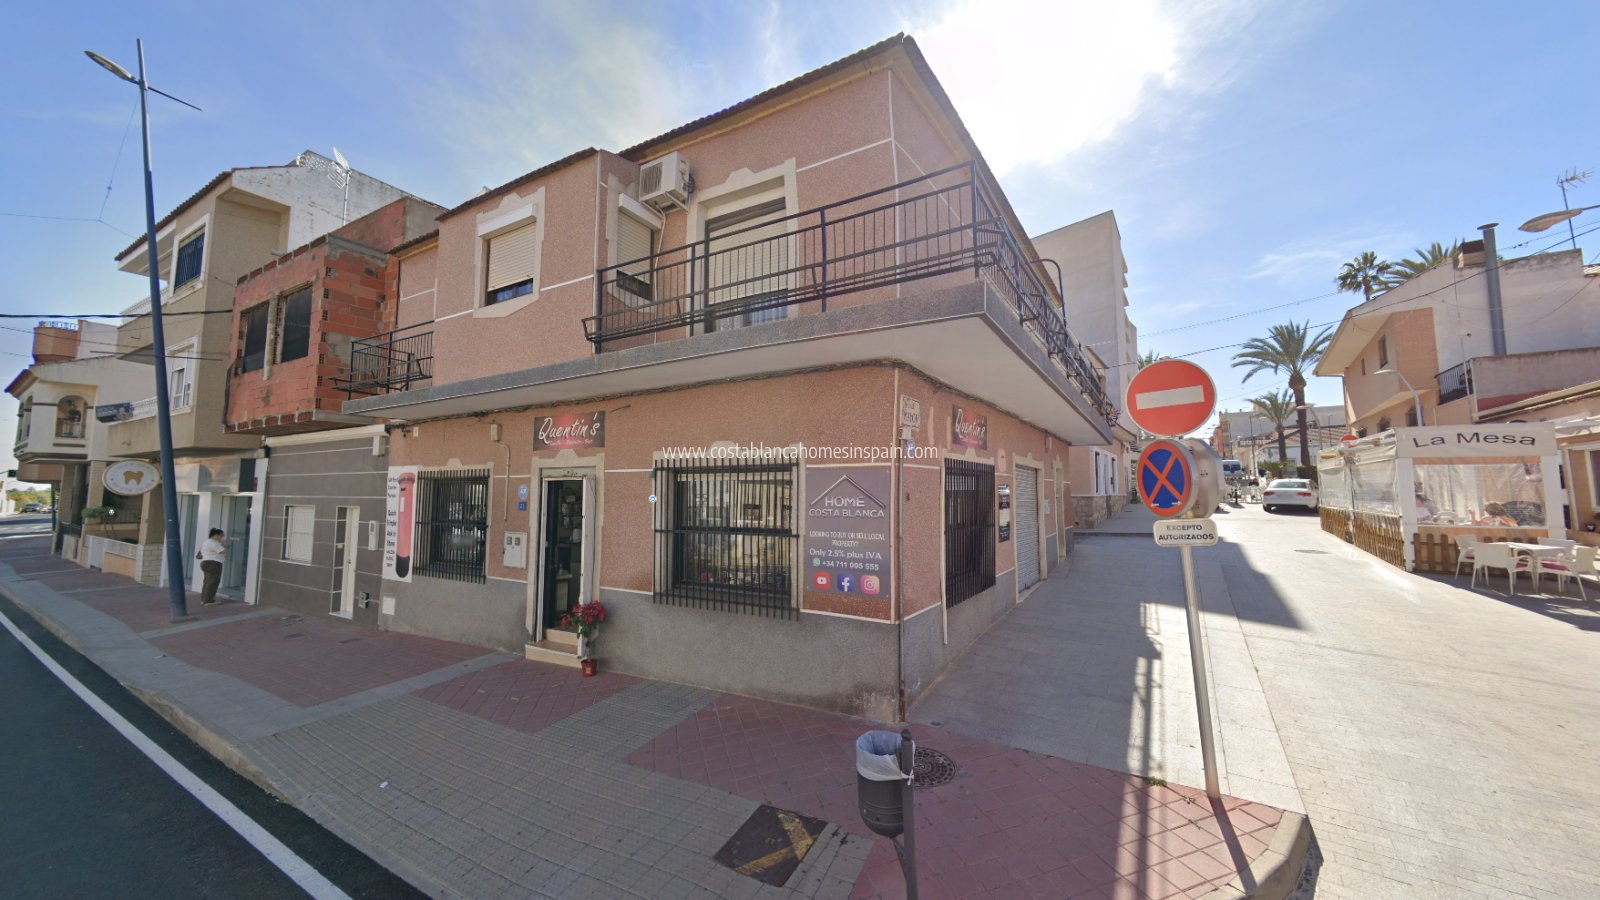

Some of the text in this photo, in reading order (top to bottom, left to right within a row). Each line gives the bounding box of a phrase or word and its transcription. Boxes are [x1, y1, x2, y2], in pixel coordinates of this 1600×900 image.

[538, 412, 600, 445] Quentin's
[1412, 432, 1536, 448] La Mesa
[825, 496, 865, 507] HOME
[809, 508, 885, 518] COSTA BLANCA
[1158, 533, 1215, 541] AUTORIZADOS
[809, 547, 882, 560] Only 2.5% plus IVA
[822, 560, 834, 568] +34
[835, 561, 848, 569] 711
